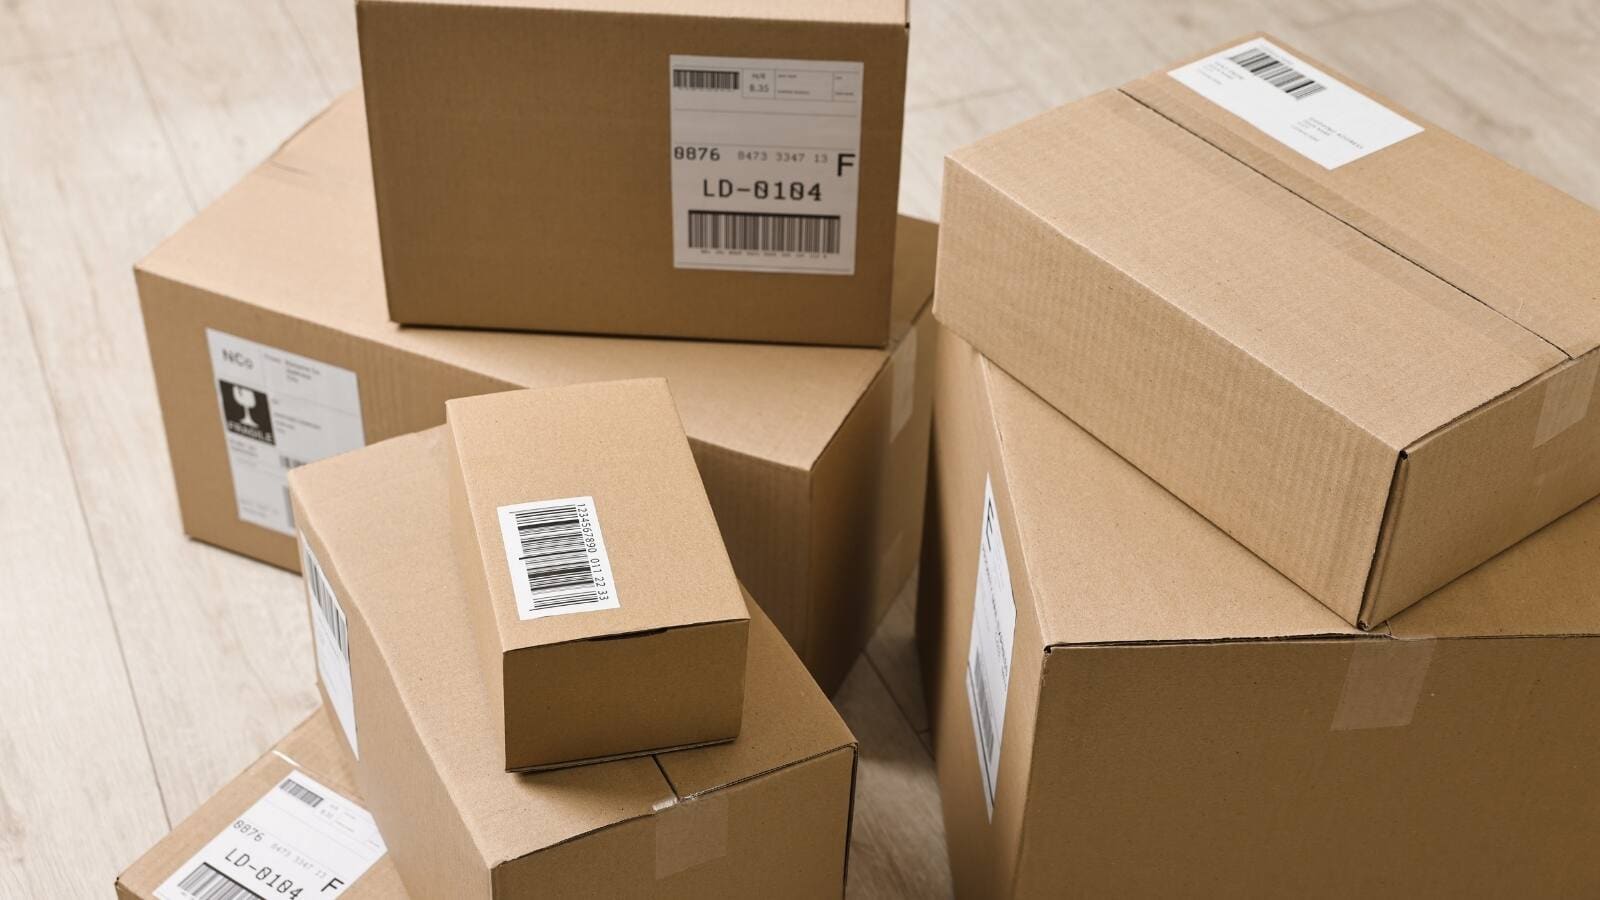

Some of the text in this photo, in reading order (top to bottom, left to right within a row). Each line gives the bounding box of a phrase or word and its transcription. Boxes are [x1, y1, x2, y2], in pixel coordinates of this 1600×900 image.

[837, 153, 856, 176] F
[703, 178, 822, 201] LD-0104
[229, 420, 275, 442] FRAGILE
[577, 503, 609, 601] 1234567890 011 22 33
[225, 848, 304, 900] LD-0104
[321, 877, 345, 892] F
